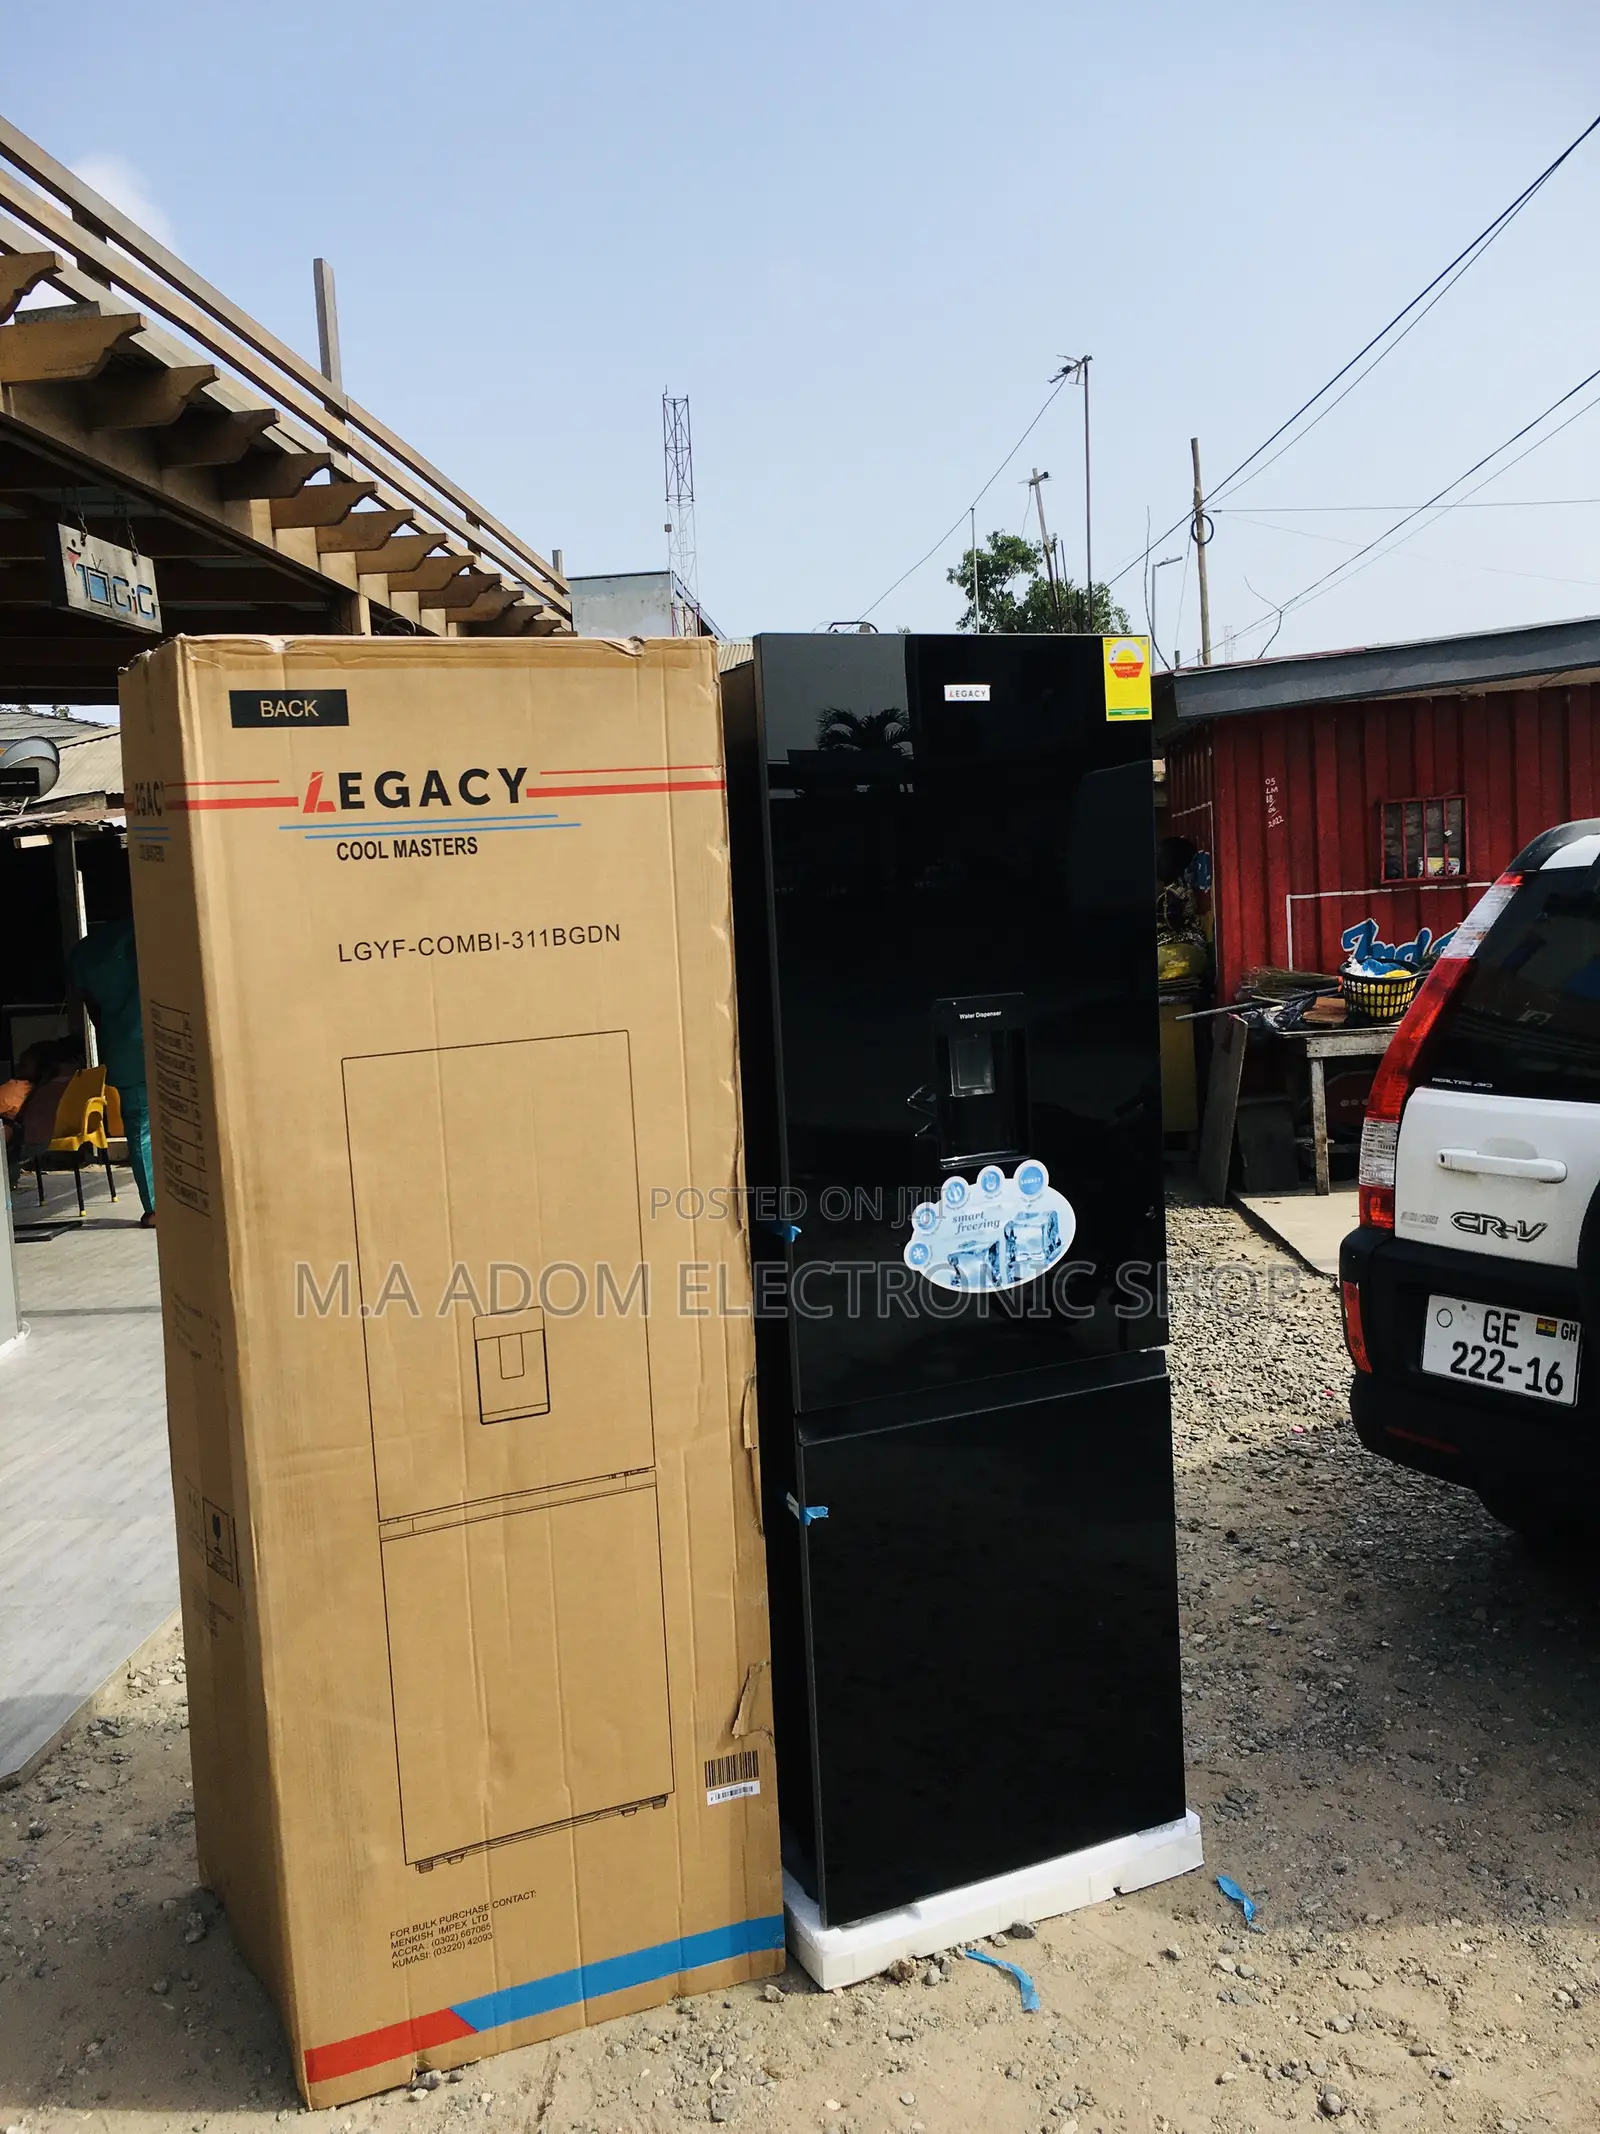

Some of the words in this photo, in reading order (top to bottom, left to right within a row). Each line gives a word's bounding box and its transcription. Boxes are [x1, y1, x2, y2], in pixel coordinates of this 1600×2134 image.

[259, 699, 319, 719] BACK
[949, 688, 986, 699] LEGACY
[302, 767, 528, 814] LEGACY
[336, 839, 389, 862] COOL
[393, 836, 479, 859] MASTERS
[337, 923, 622, 963] LGYF-COMBI-311BGDN
[975, 1010, 1002, 1019] Dispenser
[952, 1211, 985, 1223] smart
[955, 1220, 1000, 1235] freezing
[1449, 1210, 1549, 1243] CR-V
[1482, 1309, 1521, 1349] GE
[1560, 1323, 1578, 1343] GH
[1449, 1340, 1564, 1397] 222-16
[389, 1927, 411, 1940] FOR
[412, 1918, 438, 1934] BULK
[438, 1902, 491, 1926] PURCHASE
[491, 1889, 537, 1910] CONTACT:
[390, 1931, 434, 1950] MENKISH
[438, 1920, 468, 1935] IMPEX
[471, 1912, 489, 1926] LTD
[391, 1943, 425, 1960] ACCRA
[431, 1934, 459, 1949] (0302)
[460, 1922, 492, 1939] 667065
[391, 1952, 432, 1970] KUMASI:
[433, 1940, 466, 1959] (03220)
[467, 1931, 494, 1947] 42093
